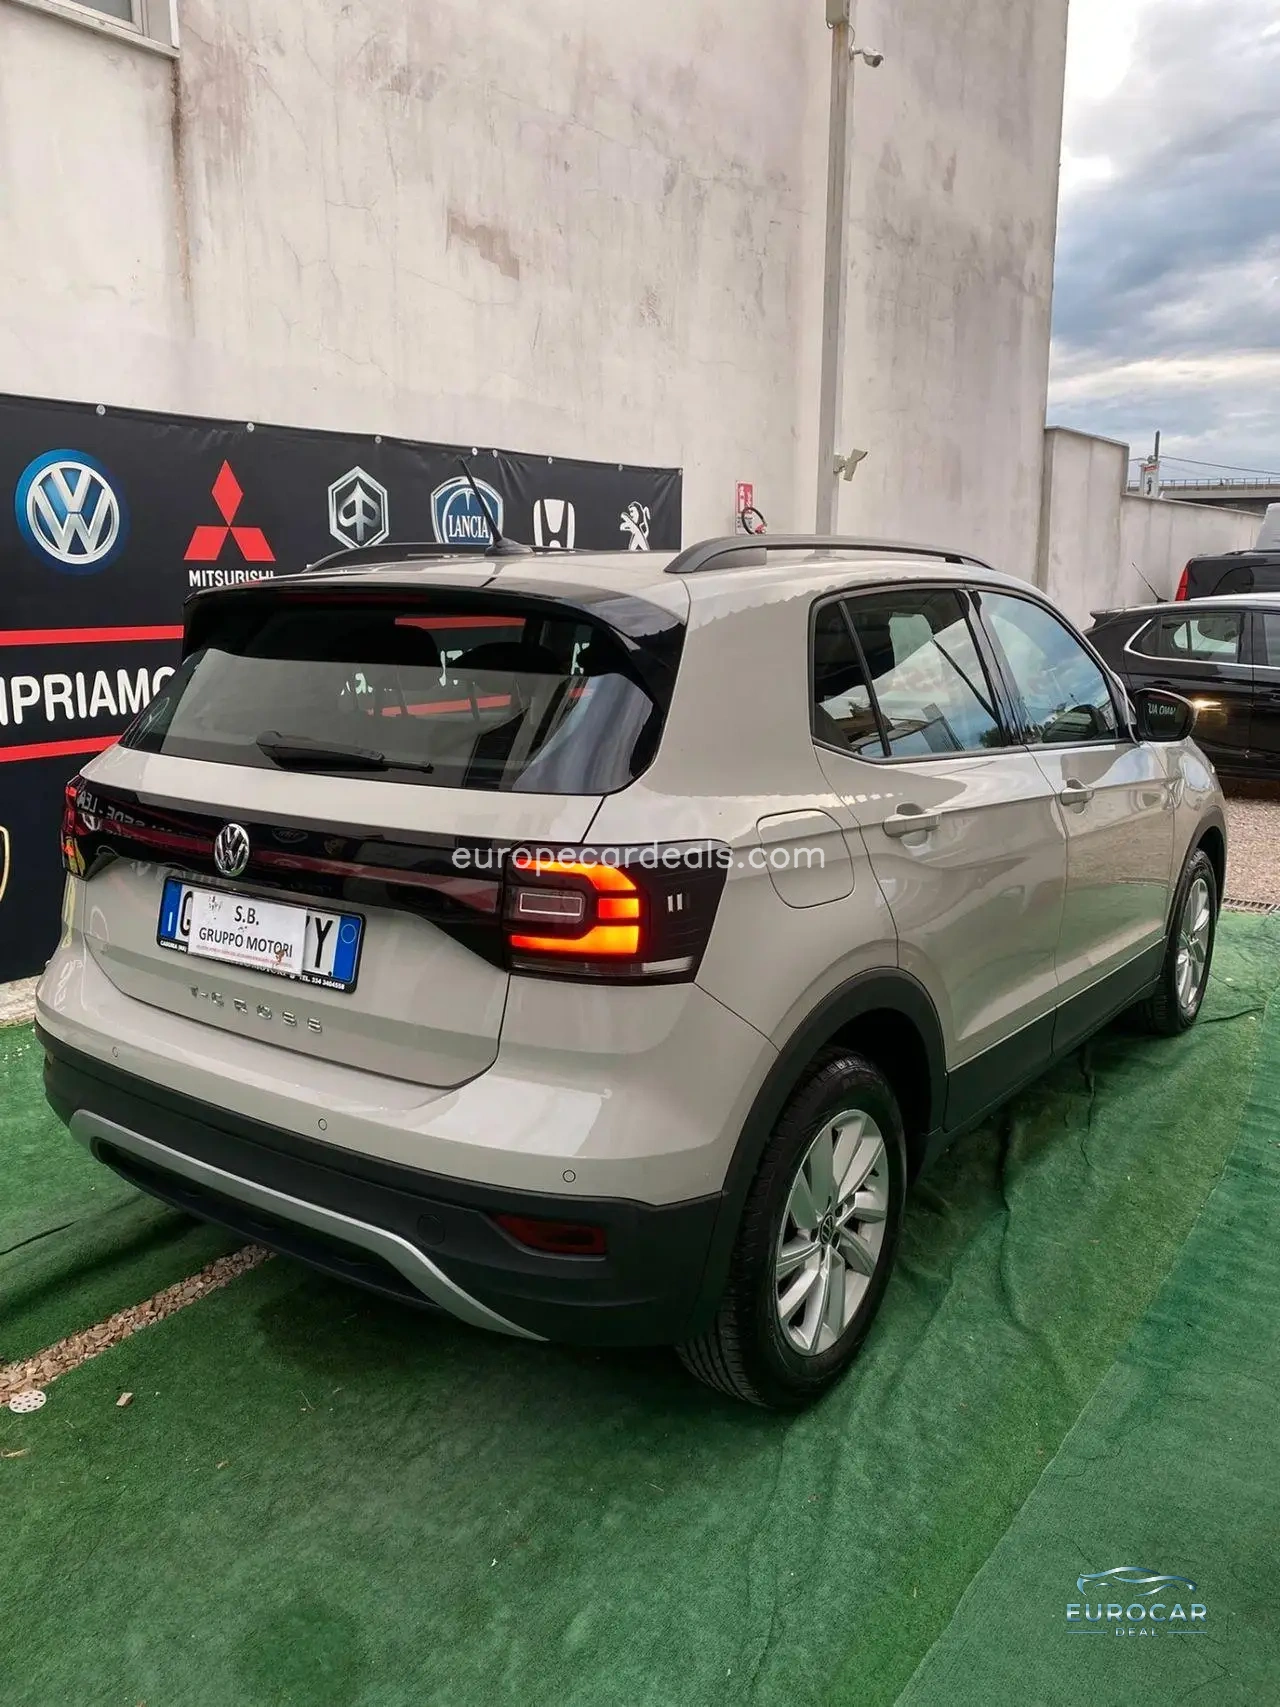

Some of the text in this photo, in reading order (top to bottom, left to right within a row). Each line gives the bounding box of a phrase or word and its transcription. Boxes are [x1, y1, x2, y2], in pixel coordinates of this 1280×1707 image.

[448, 514, 490, 539] LANCIA
[234, 905, 260, 926] S.B.
[199, 926, 244, 948] GRUPPO
[246, 940, 293, 958] MOTORI
[190, 985, 323, 1034] T-CROSS
